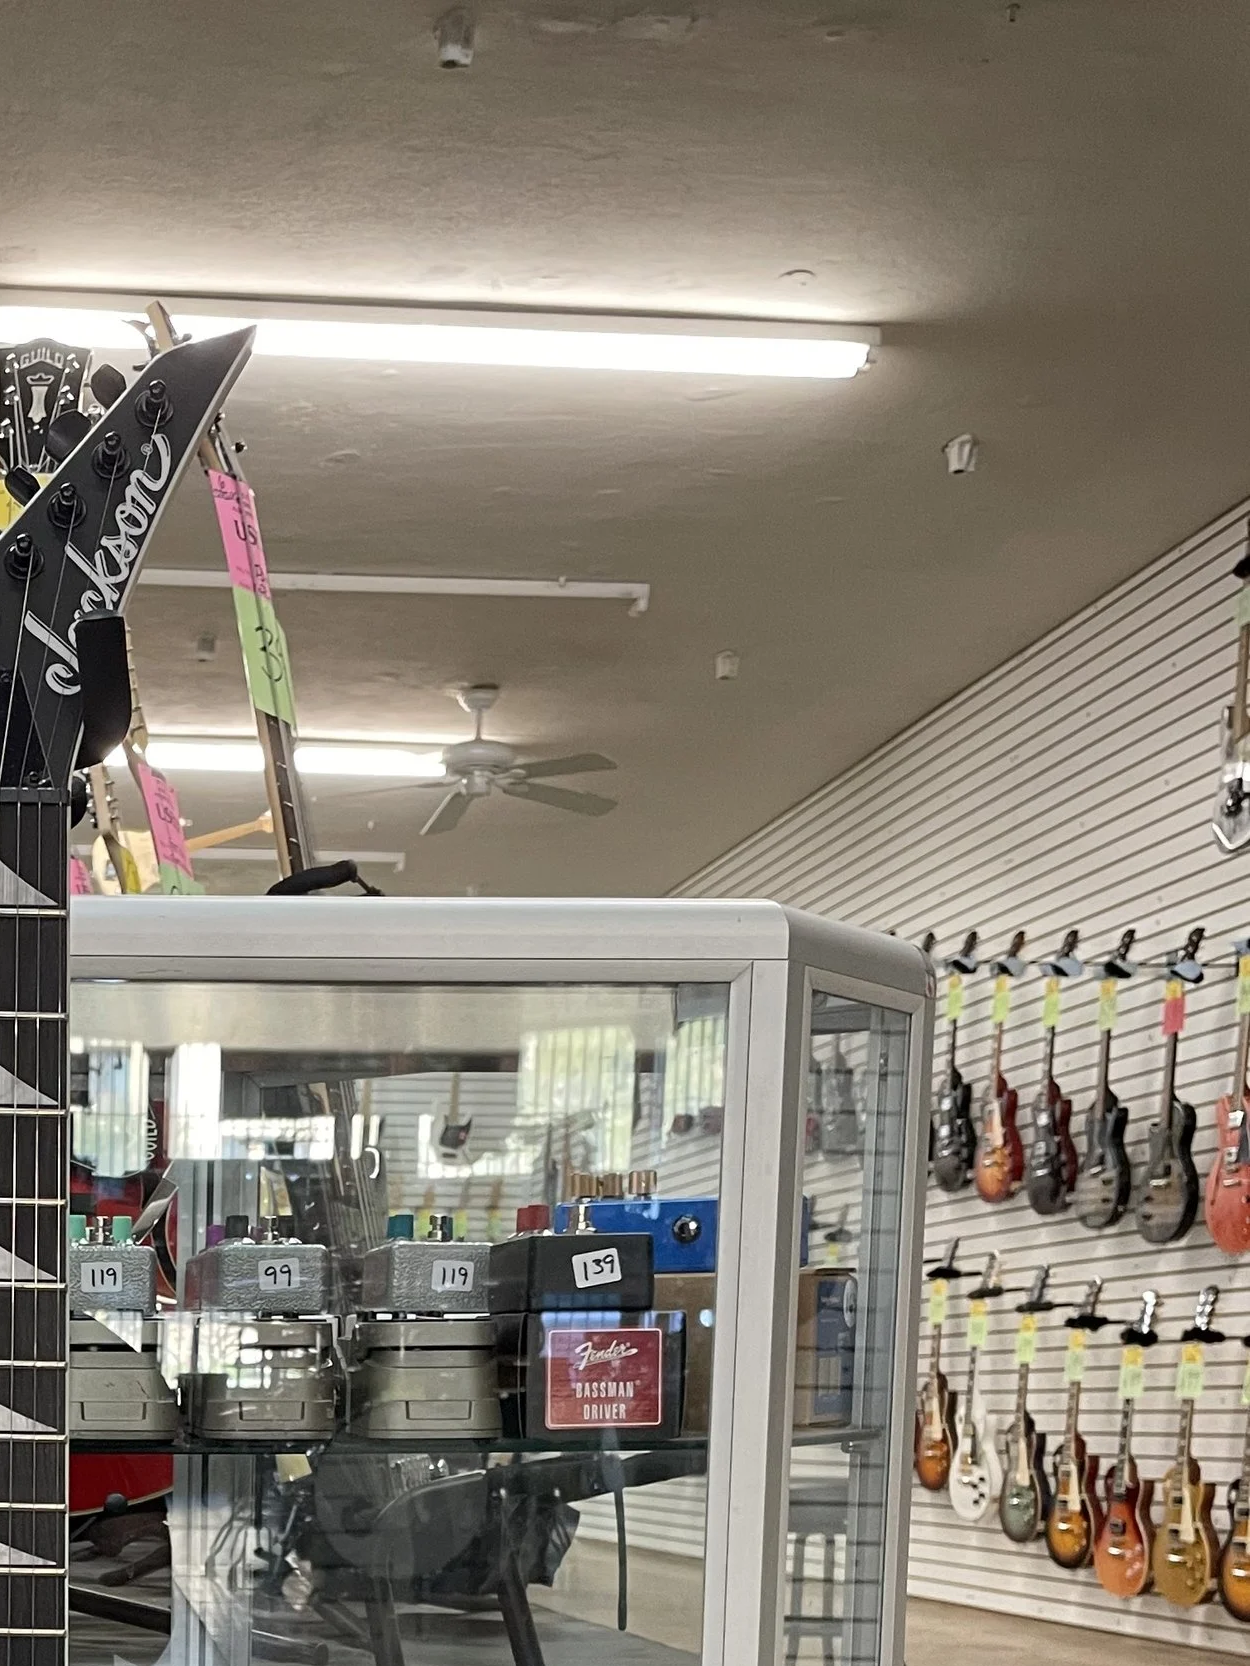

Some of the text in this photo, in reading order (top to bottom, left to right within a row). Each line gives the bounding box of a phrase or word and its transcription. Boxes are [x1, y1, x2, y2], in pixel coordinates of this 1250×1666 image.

[19, 347, 65, 369] GUILD
[25, 433, 171, 695] Jckson
[90, 1267, 117, 1287] 119
[264, 1264, 292, 1287] 99
[440, 1267, 468, 1287] 119
[583, 1254, 615, 1281] 139
[572, 1339, 639, 1371] Fender
[575, 1381, 635, 1399] BASSMAN
[583, 1403, 626, 1420] DRIVER
